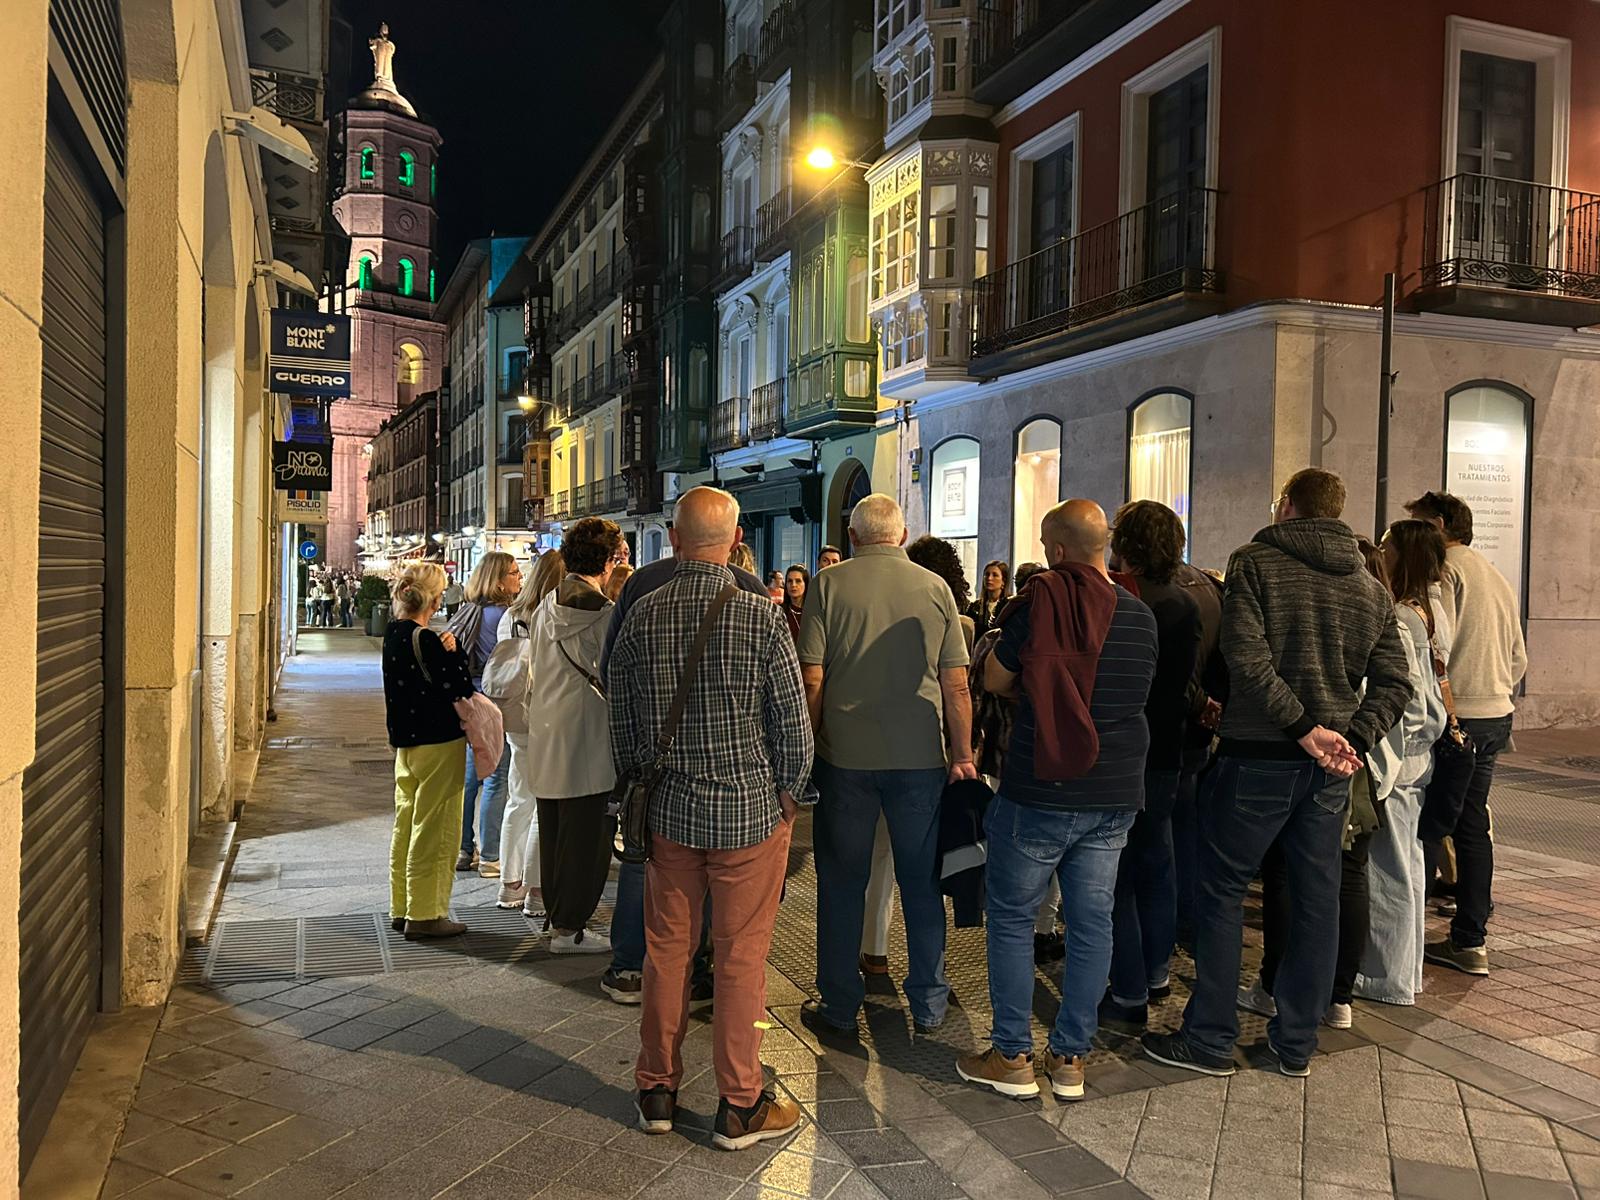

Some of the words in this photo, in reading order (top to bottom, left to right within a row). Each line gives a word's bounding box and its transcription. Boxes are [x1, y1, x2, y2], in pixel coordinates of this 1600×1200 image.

[286, 326, 325, 339] MONT
[286, 336, 325, 350] BLANC
[275, 372, 345, 386] GUERRO
[288, 451, 322, 469] NO
[275, 463, 330, 480] Drama
[1468, 463, 1504, 472] NUESTROS
[1458, 472, 1511, 482] TRATAMIENTOS
[287, 500, 321, 508] PISOLID
